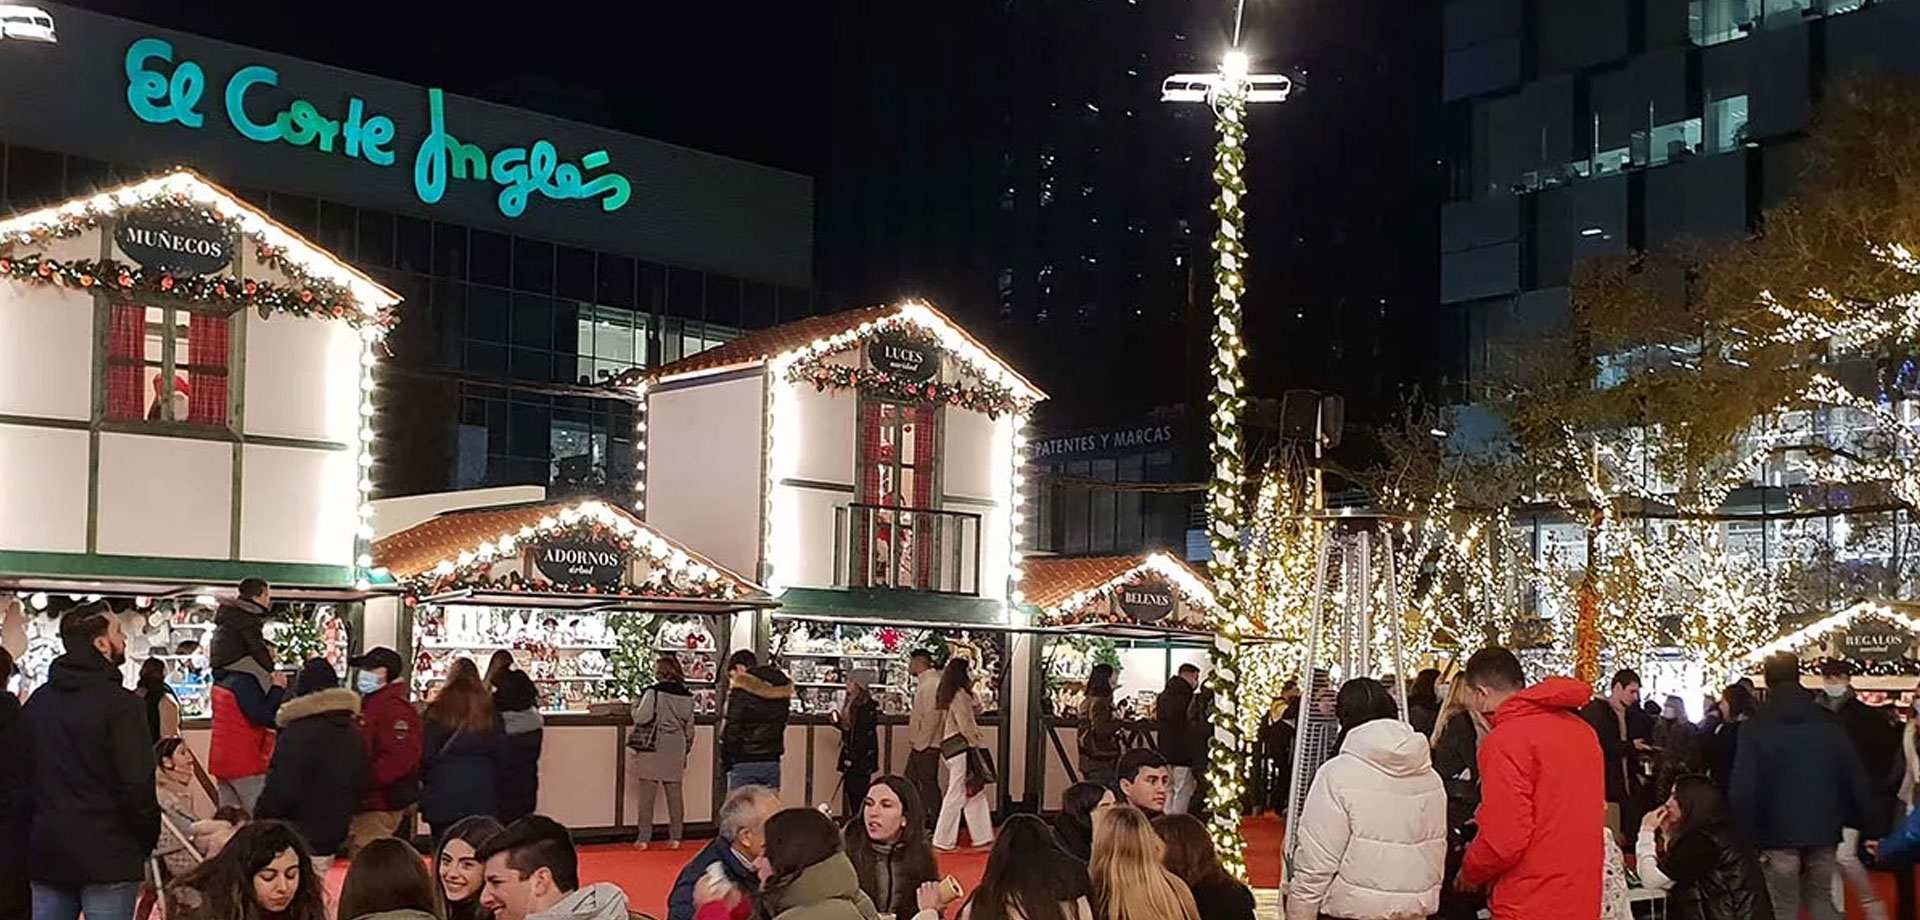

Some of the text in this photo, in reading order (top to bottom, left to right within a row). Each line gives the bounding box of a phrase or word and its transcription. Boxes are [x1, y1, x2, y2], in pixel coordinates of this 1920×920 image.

[125, 38, 632, 218] El Corte Inglés
[126, 227, 222, 258] MUÑECOS
[885, 345, 923, 363] LUCES
[1035, 426, 1171, 457] PATENTES Y MARCAS
[543, 548, 618, 567] ADORNOS
[1125, 592, 1169, 606] BELENES
[1845, 635, 1902, 646] REGALOS
